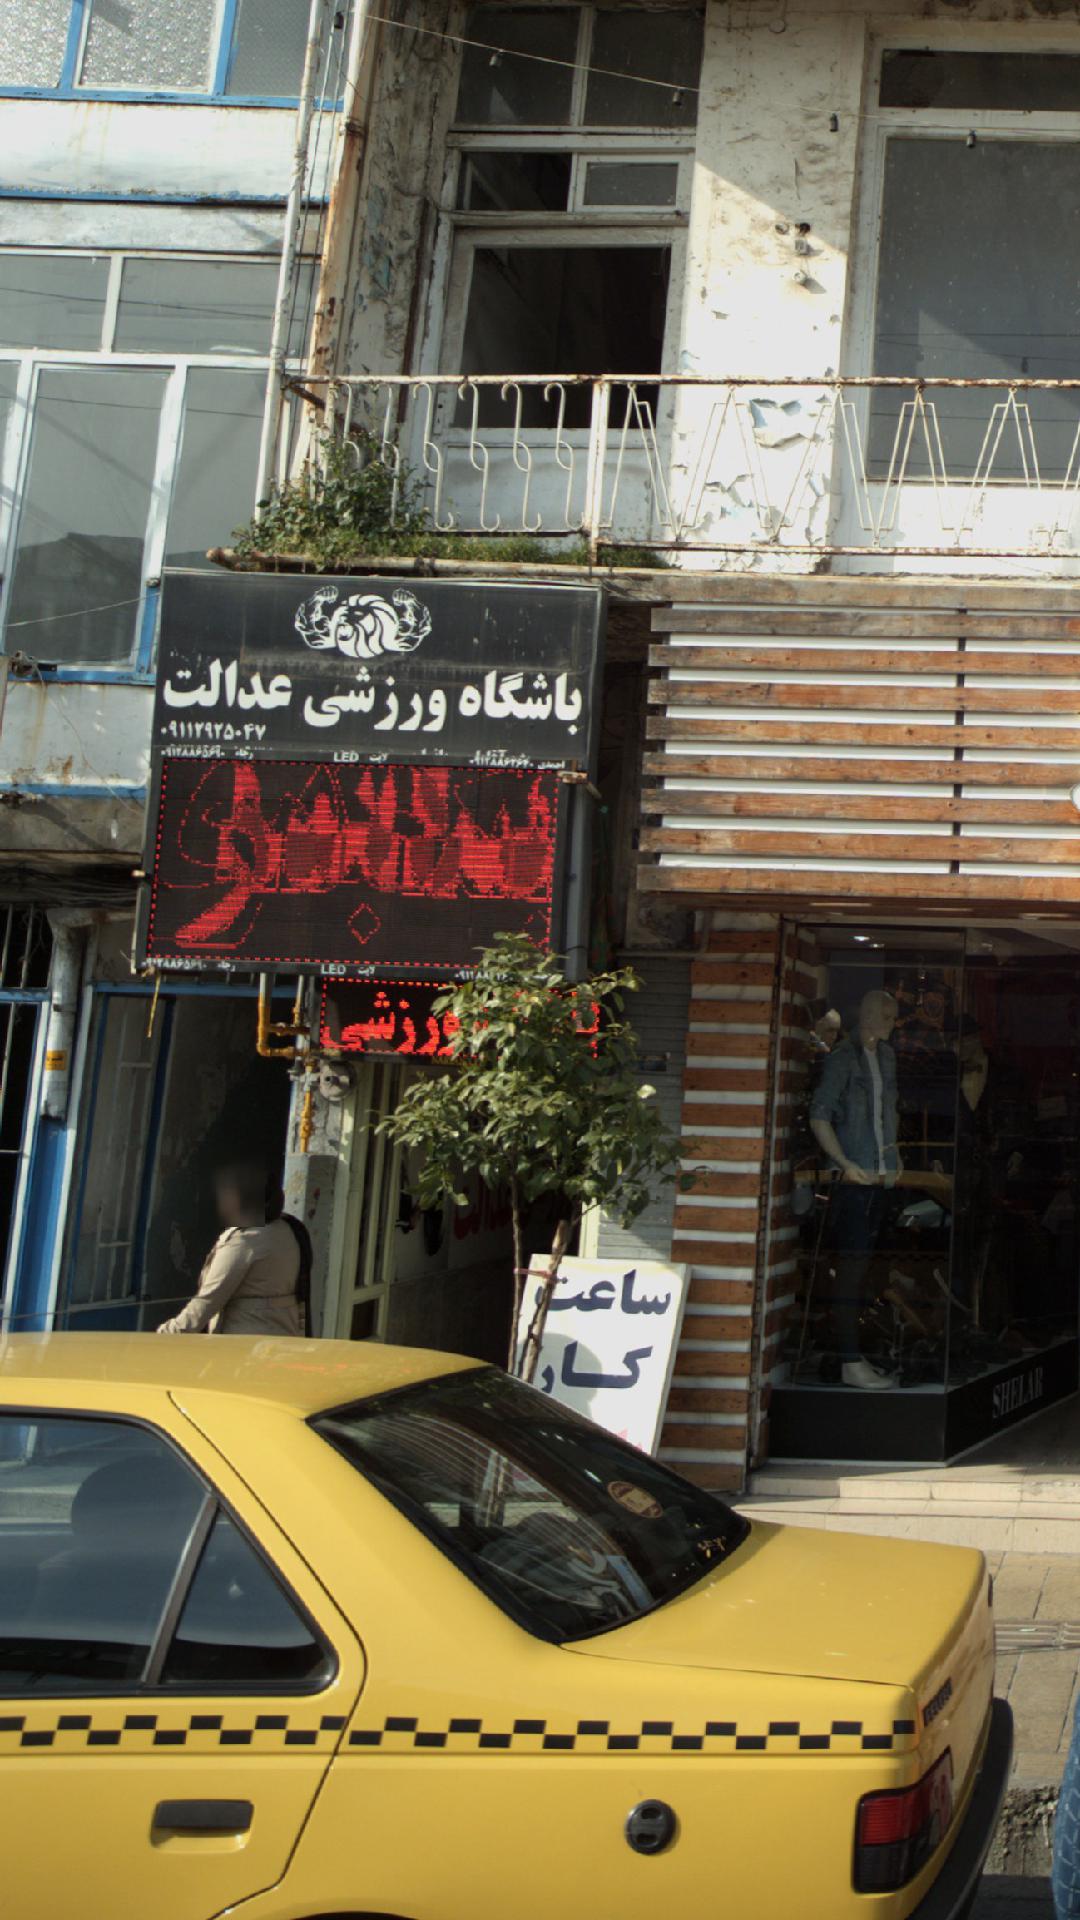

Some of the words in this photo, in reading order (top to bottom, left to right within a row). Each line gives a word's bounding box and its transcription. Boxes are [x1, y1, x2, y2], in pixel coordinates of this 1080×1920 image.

[163, 658, 293, 710] عدالت
[304, 666, 448, 732] ورزشی
[458, 669, 582, 735] باشگاه
[160, 719, 267, 741] ۰۹۱۱۲۹۲۵۰۴۷
[333, 751, 360, 762] LED
[320, 963, 347, 975] LED
[534, 1268, 672, 1315] ساعت
[541, 1340, 654, 1394] کار
